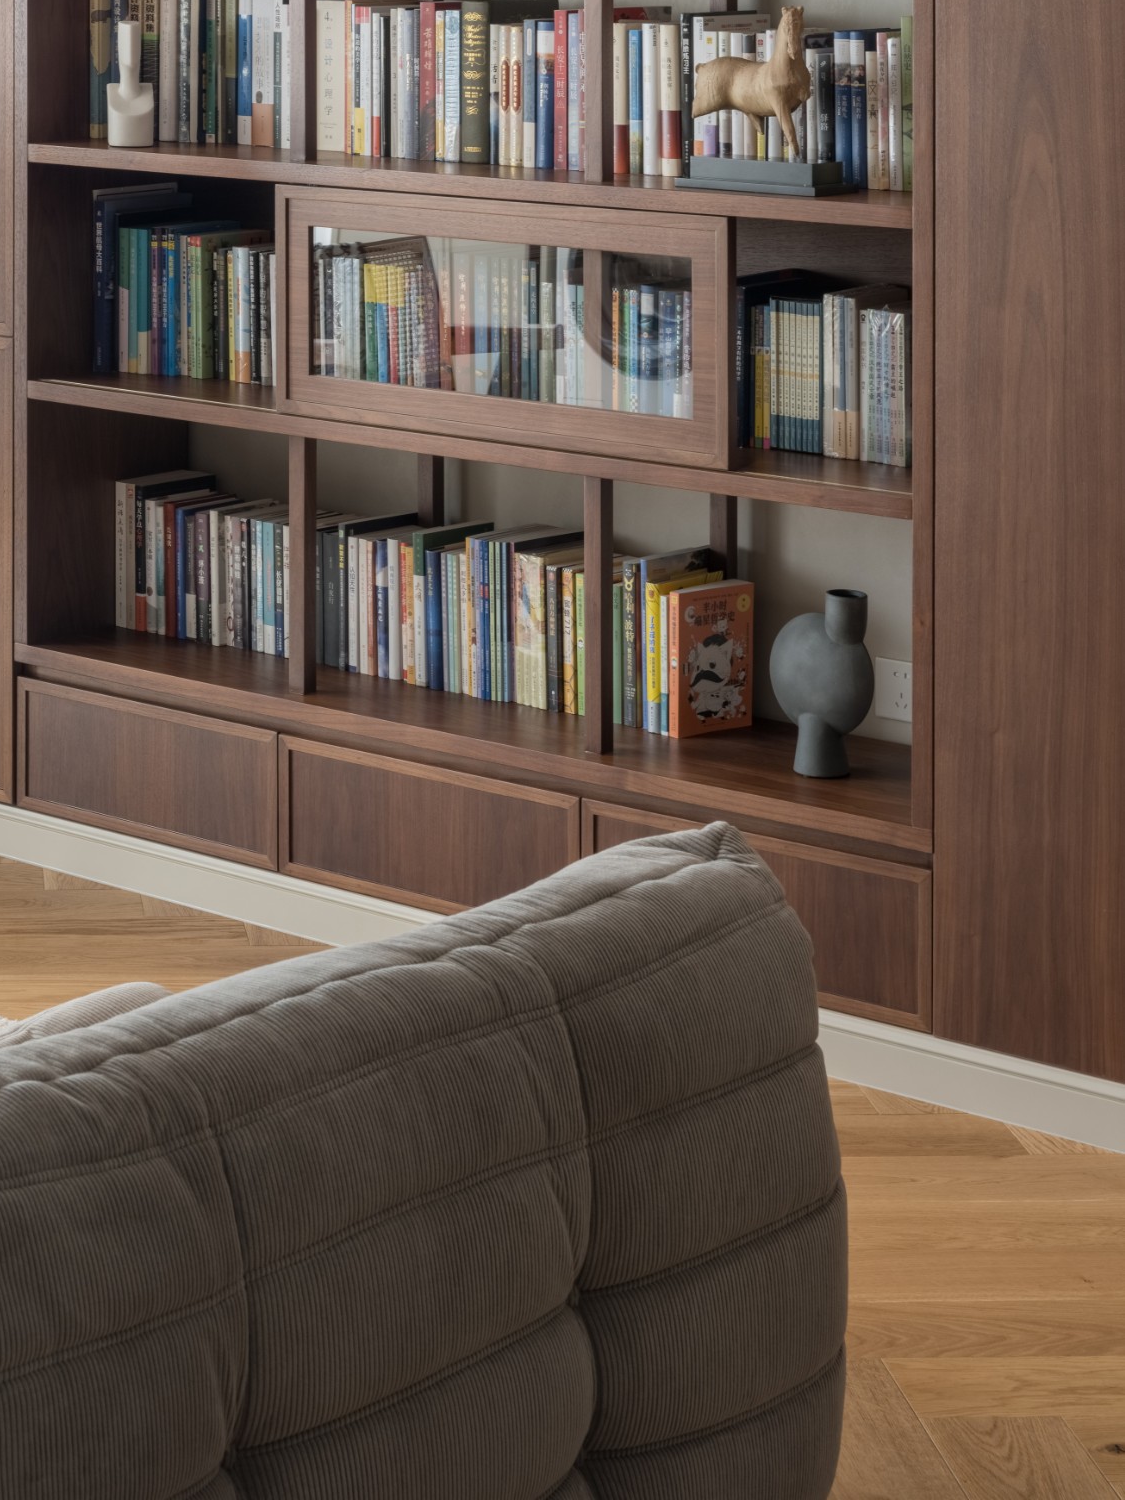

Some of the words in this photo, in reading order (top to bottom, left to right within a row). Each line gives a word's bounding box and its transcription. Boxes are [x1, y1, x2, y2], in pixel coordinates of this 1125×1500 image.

[556, 45, 567, 99] 长安十二时辰
[703, 599, 728, 613] 半小时
